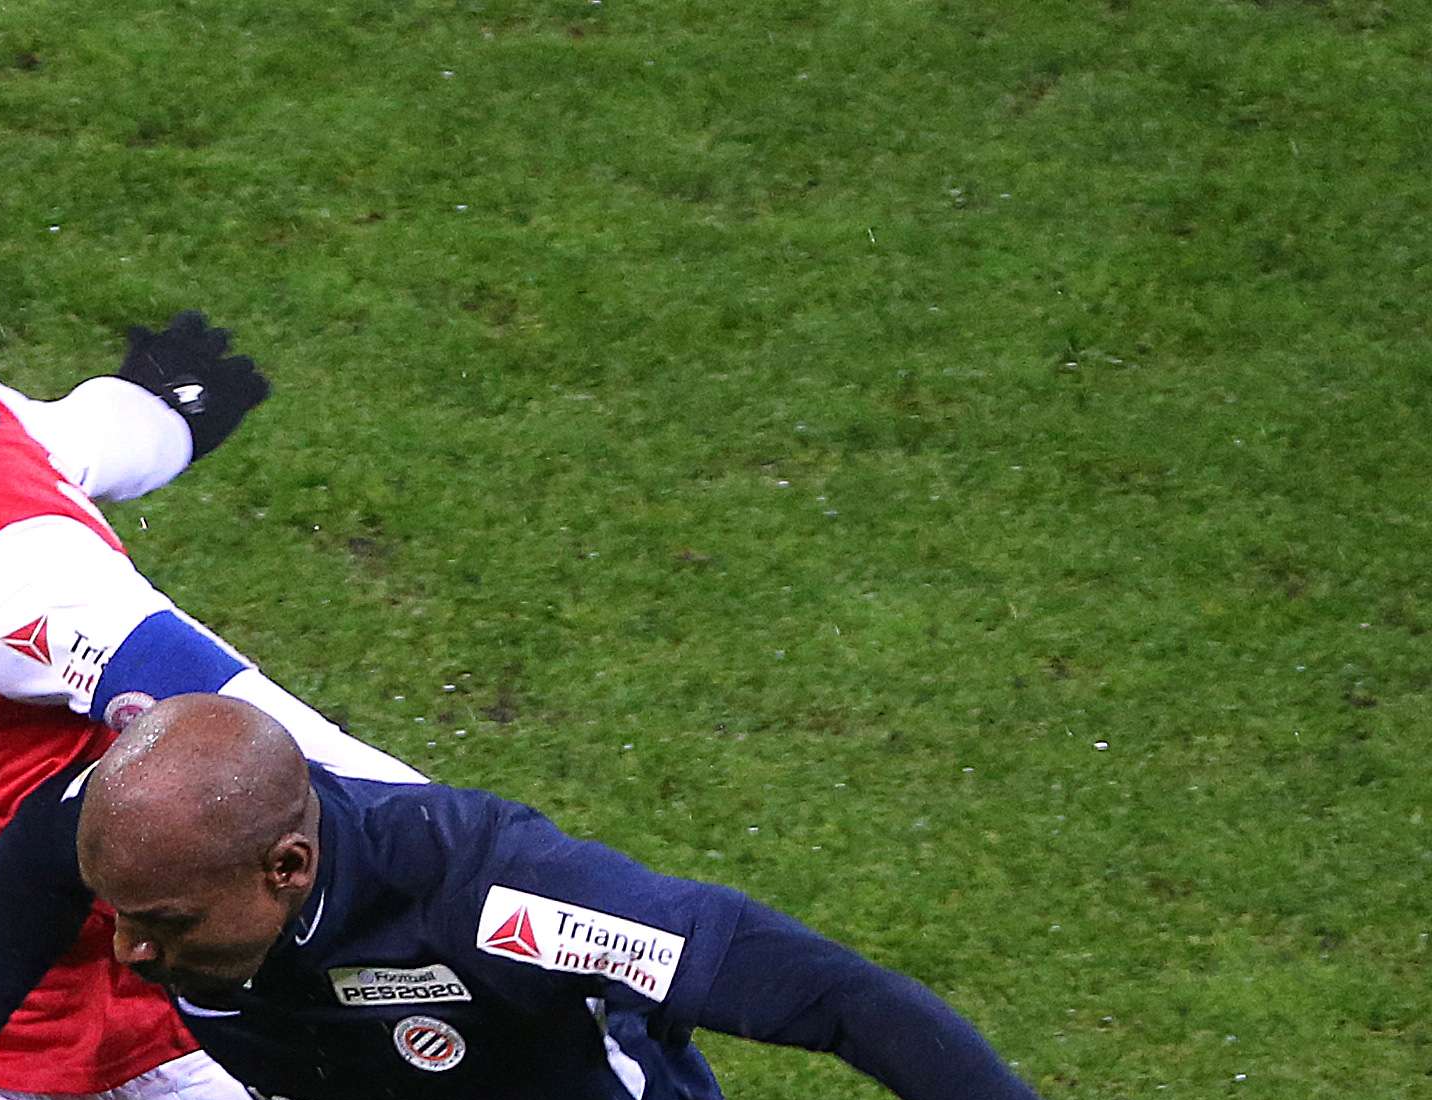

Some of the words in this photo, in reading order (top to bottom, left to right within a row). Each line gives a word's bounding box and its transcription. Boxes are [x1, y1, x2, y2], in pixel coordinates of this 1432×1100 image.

[70, 629, 109, 672] Tri
[556, 910, 673, 967] Triangle
[342, 983, 465, 1001] PES2020
